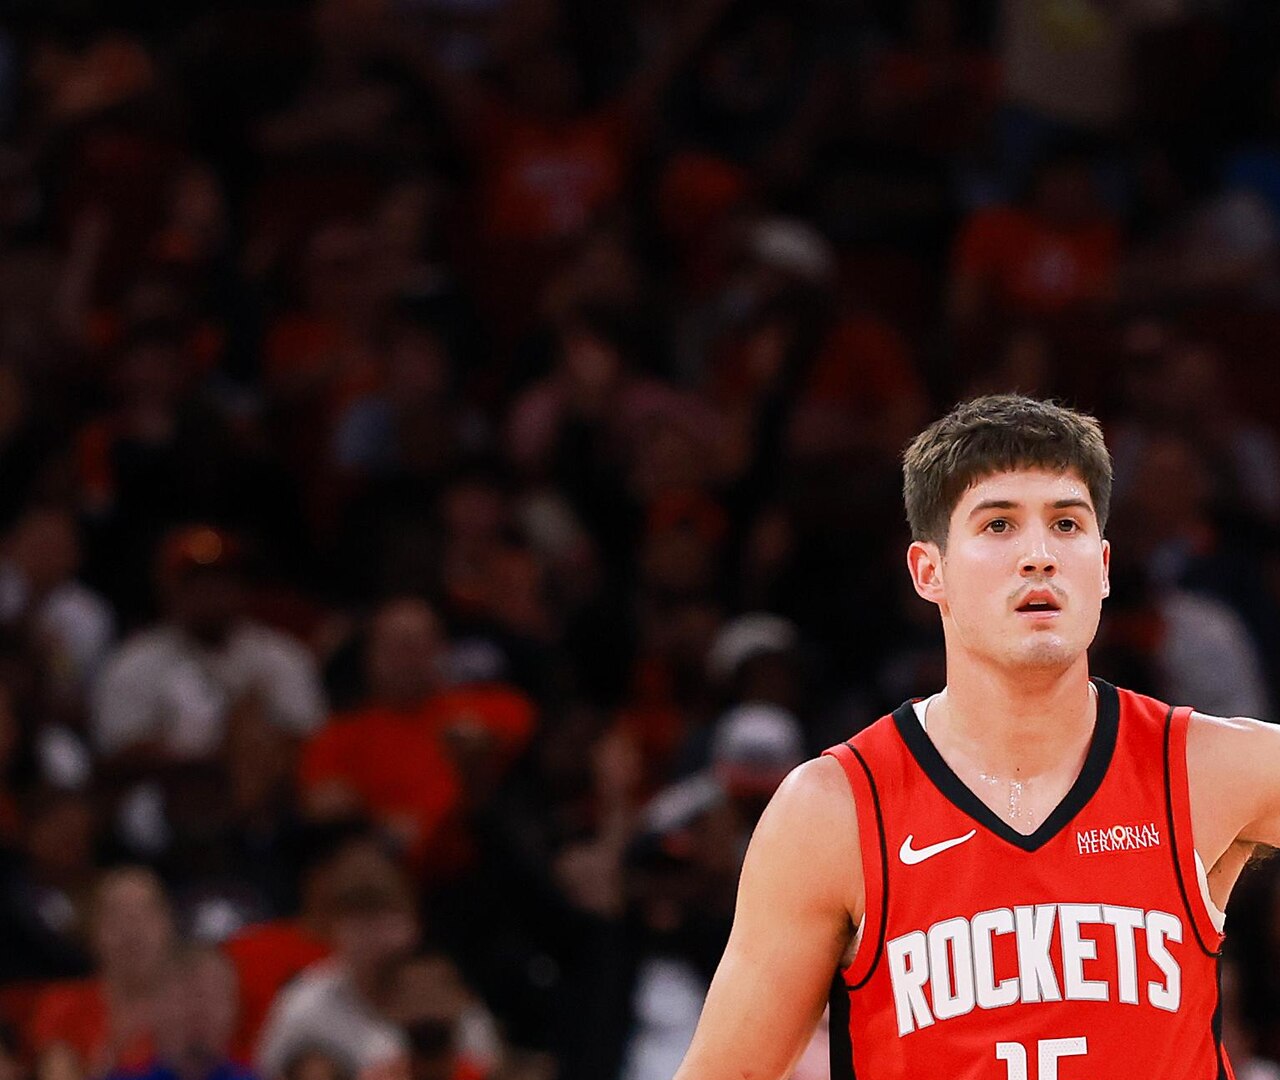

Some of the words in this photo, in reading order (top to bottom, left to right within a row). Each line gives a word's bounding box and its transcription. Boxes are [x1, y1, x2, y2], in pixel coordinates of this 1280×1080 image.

[1077, 823, 1159, 843] MEMORIAL
[1078, 834, 1159, 854] HERMANN
[886, 902, 1183, 1038] ROCKETS
